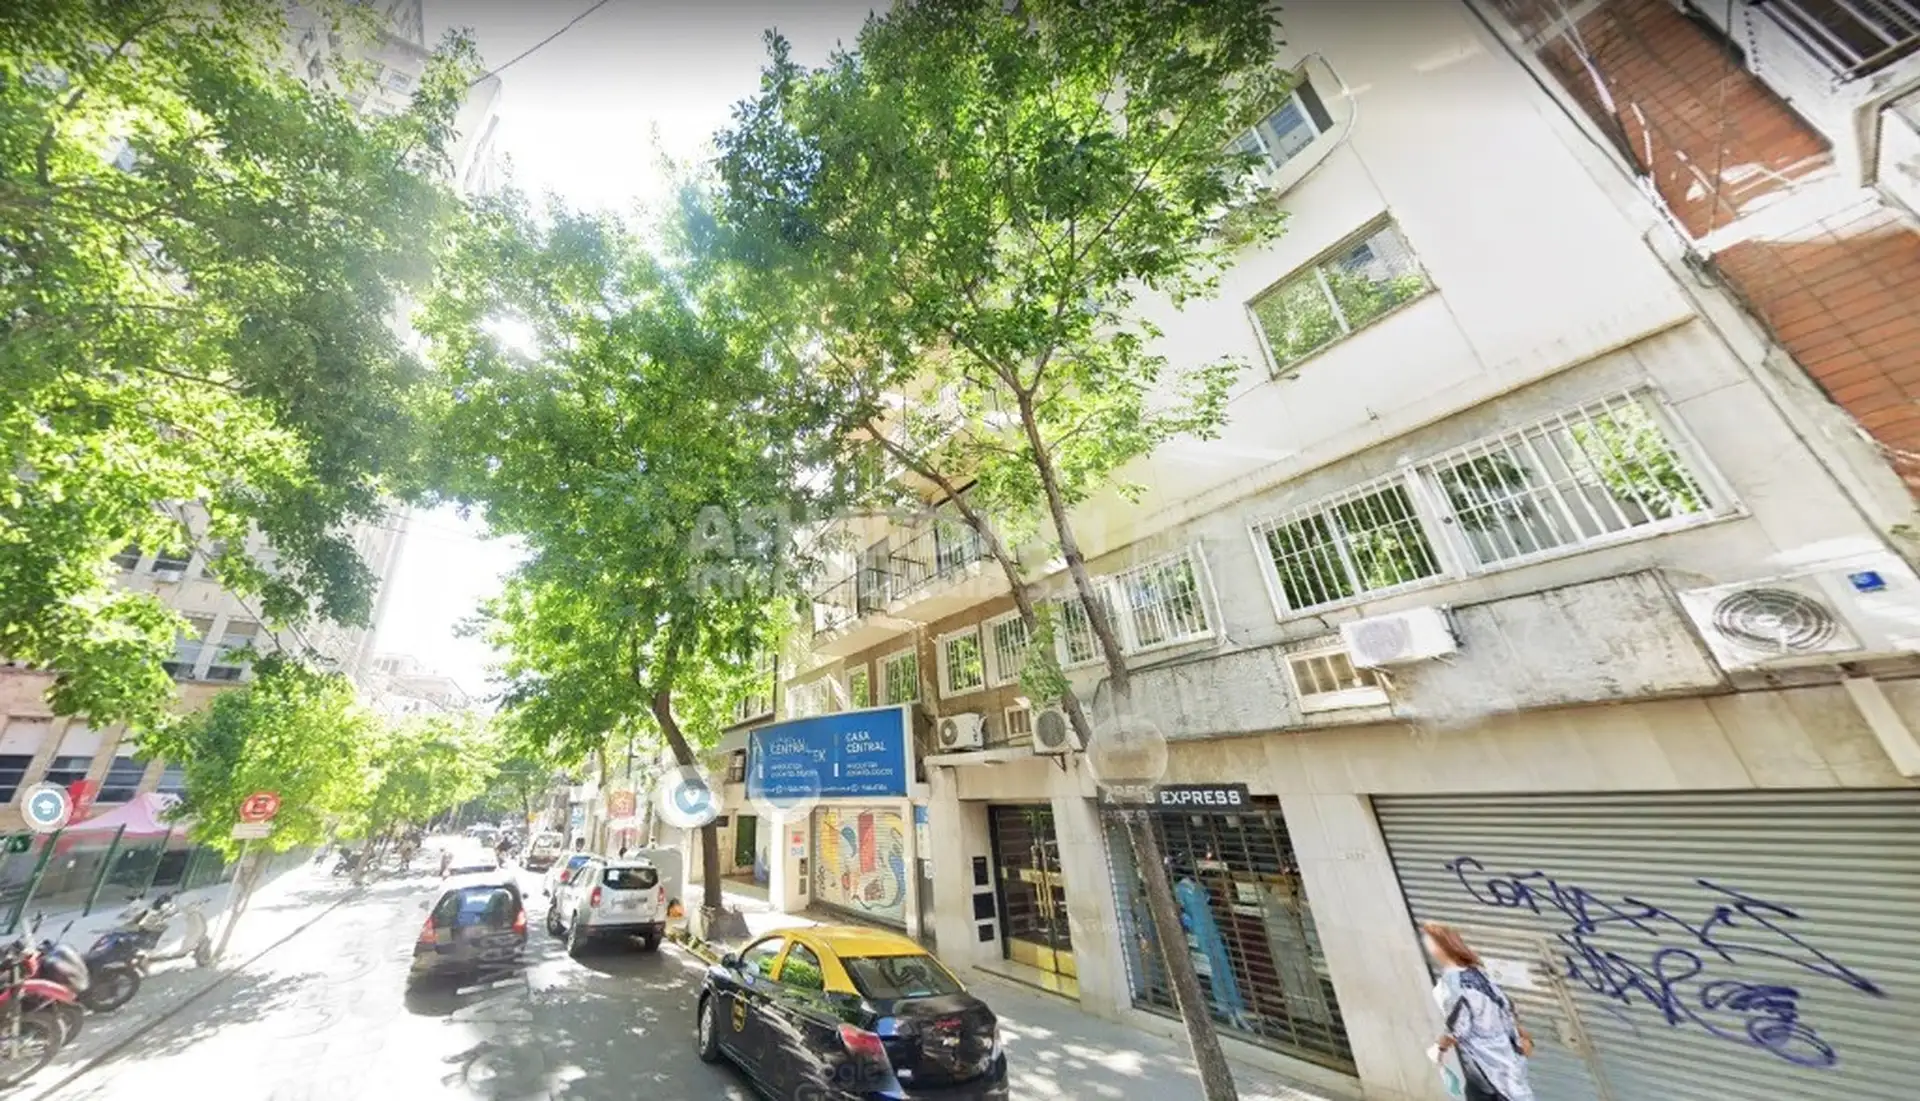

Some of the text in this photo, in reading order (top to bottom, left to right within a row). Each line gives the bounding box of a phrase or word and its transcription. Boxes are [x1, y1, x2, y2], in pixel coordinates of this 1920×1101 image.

[845, 731, 870, 741] CASA
[845, 741, 887, 753] CENTRAL
[1160, 790, 1241, 805] EXPRESS
